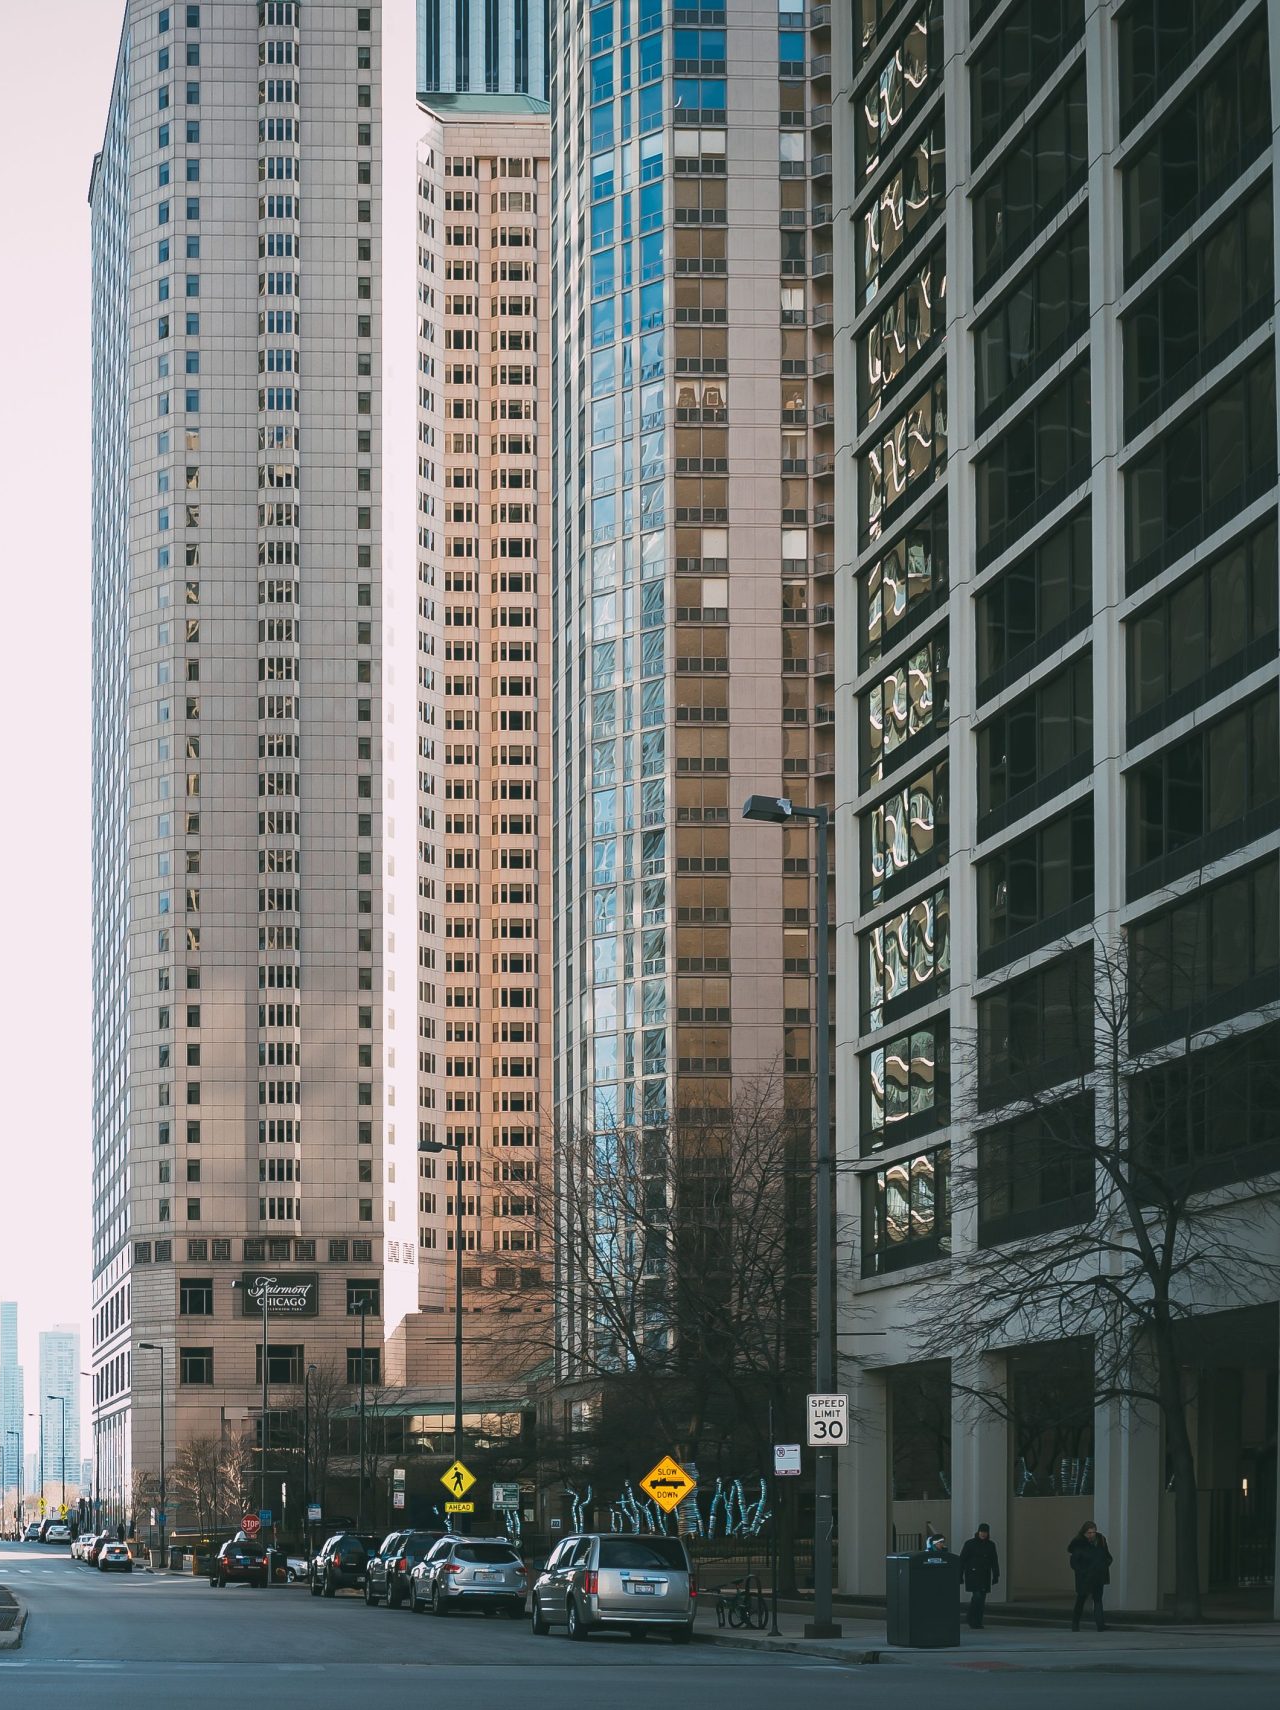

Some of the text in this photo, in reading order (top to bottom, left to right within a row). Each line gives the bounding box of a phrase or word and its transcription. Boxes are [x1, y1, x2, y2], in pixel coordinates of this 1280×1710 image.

[248, 1276, 313, 1297] Fairmont
[257, 1297, 306, 1306] CHICAGO
[814, 1421, 843, 1438] 30
[243, 1520, 260, 1528] STOP
